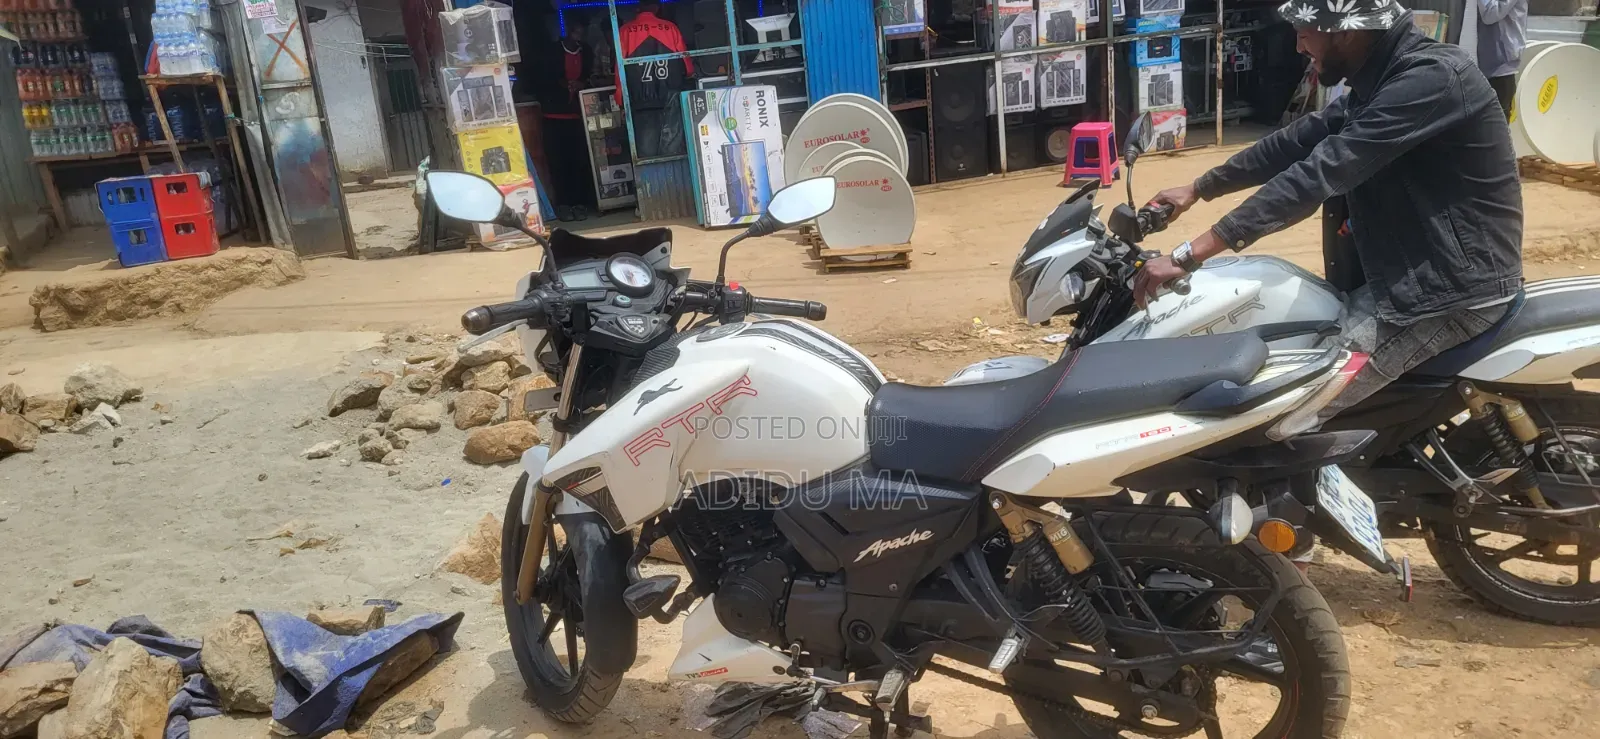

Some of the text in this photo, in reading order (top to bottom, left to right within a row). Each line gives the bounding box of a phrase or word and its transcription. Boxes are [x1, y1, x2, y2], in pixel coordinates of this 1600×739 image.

[639, 59, 669, 82] 78
[756, 90, 769, 128] RONIX
[804, 130, 860, 149] EUROSOLAR
[837, 180, 880, 189] EUROSOLAR
[1178, 294, 1266, 338] TR
[623, 374, 757, 467] RTR
[853, 527, 936, 563] Apache
[1049, 526, 1069, 543] MIG
